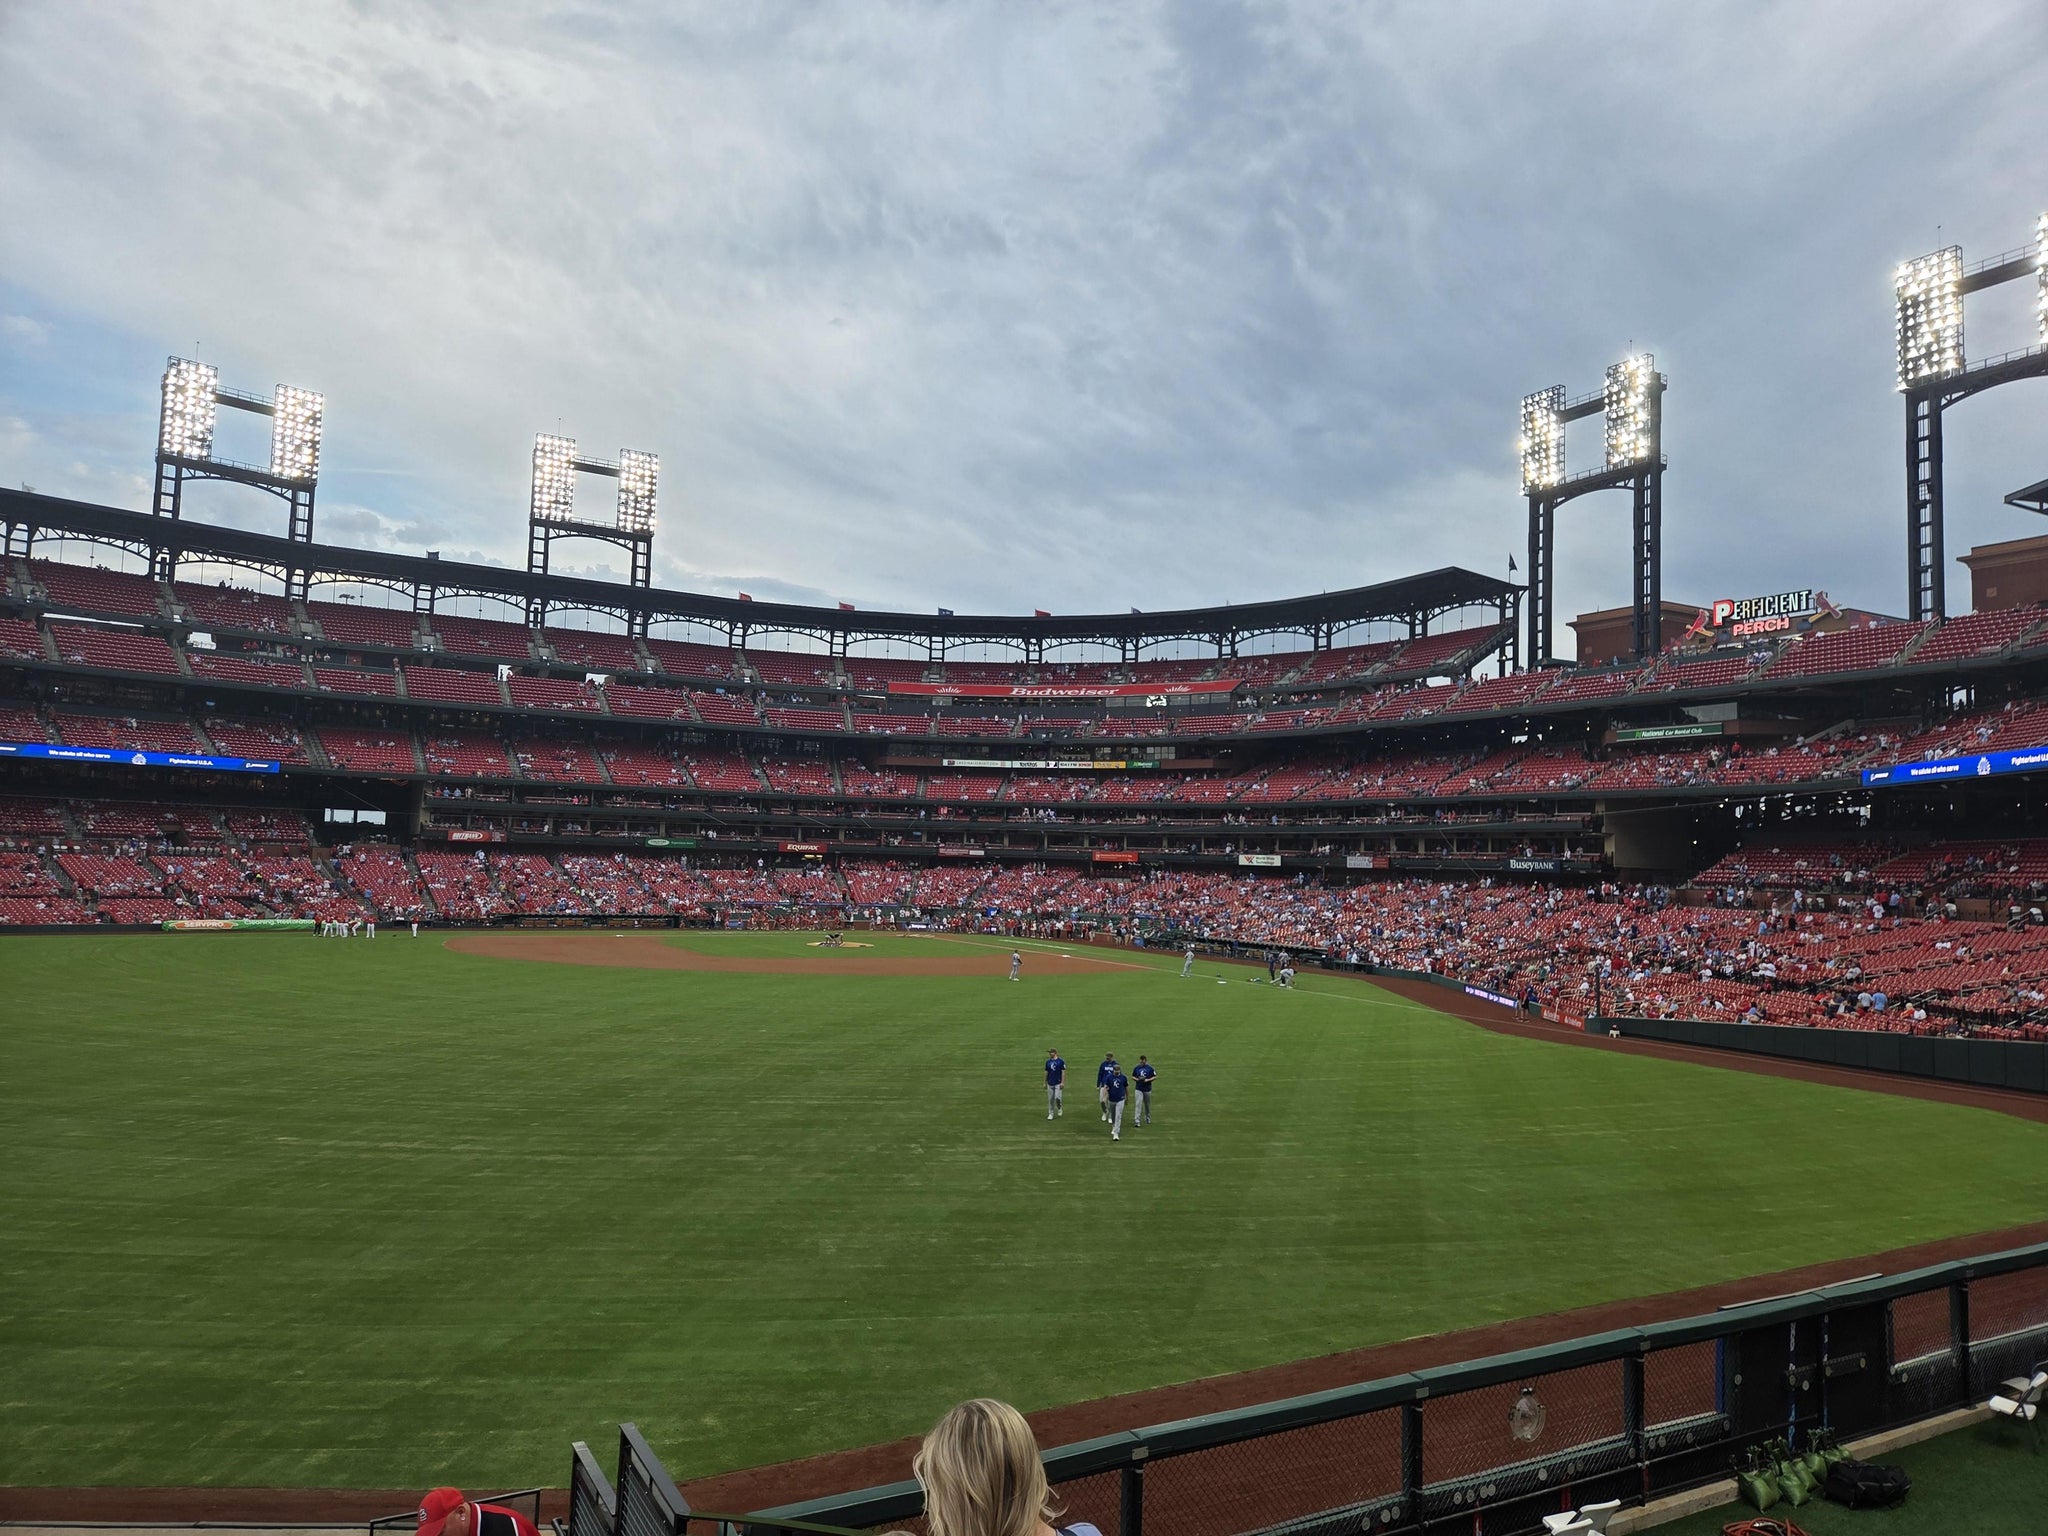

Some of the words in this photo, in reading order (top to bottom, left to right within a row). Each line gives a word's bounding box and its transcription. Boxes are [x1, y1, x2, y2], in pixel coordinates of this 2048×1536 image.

[1713, 590, 1810, 626] PERFICIENT
[1733, 618, 1790, 636] PERCH
[1010, 687, 1119, 696] Budweiser
[1641, 729, 1665, 738] National
[787, 843, 819, 851] EQUIFAX
[184, 920, 225, 929] SERVPRO
